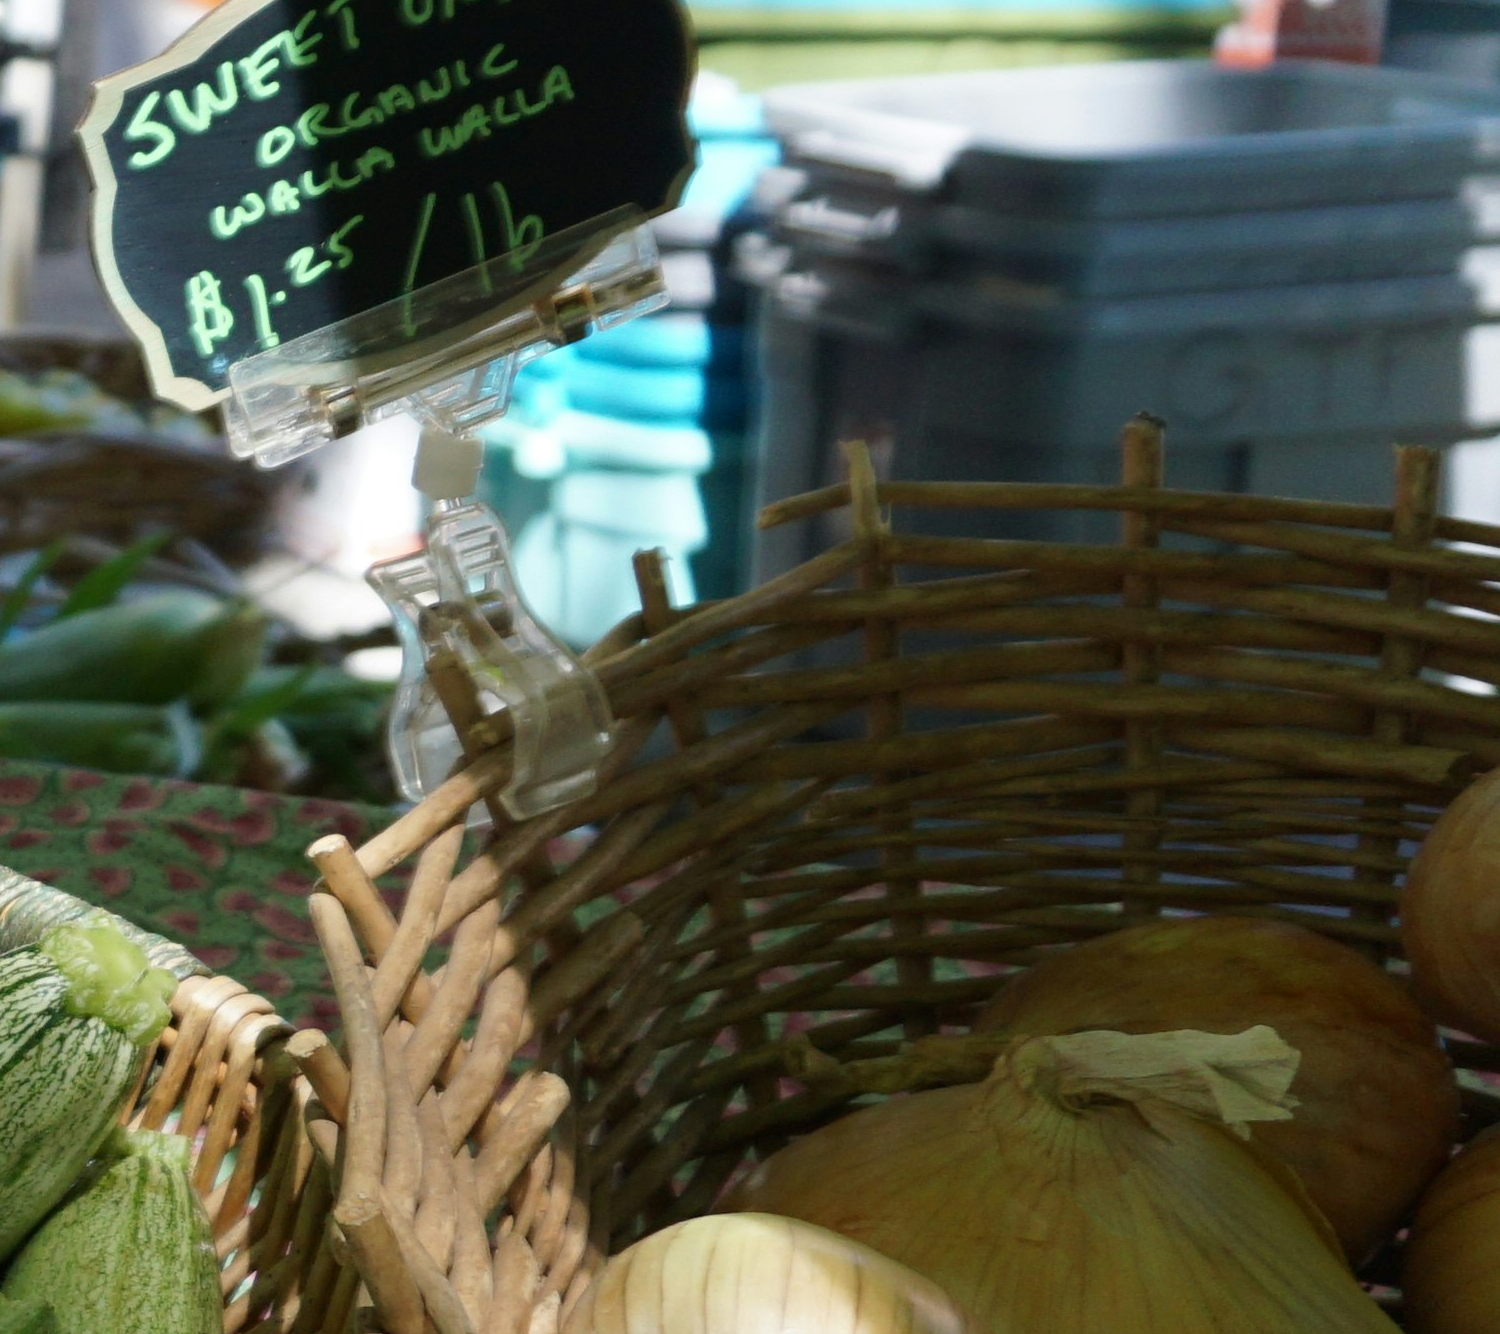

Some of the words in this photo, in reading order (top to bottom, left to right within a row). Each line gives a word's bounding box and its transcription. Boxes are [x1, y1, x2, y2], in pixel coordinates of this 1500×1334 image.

[209, 146, 395, 240] WALLA
[418, 64, 576, 157] WALLA
[257, 42, 521, 167] ORGANIC
